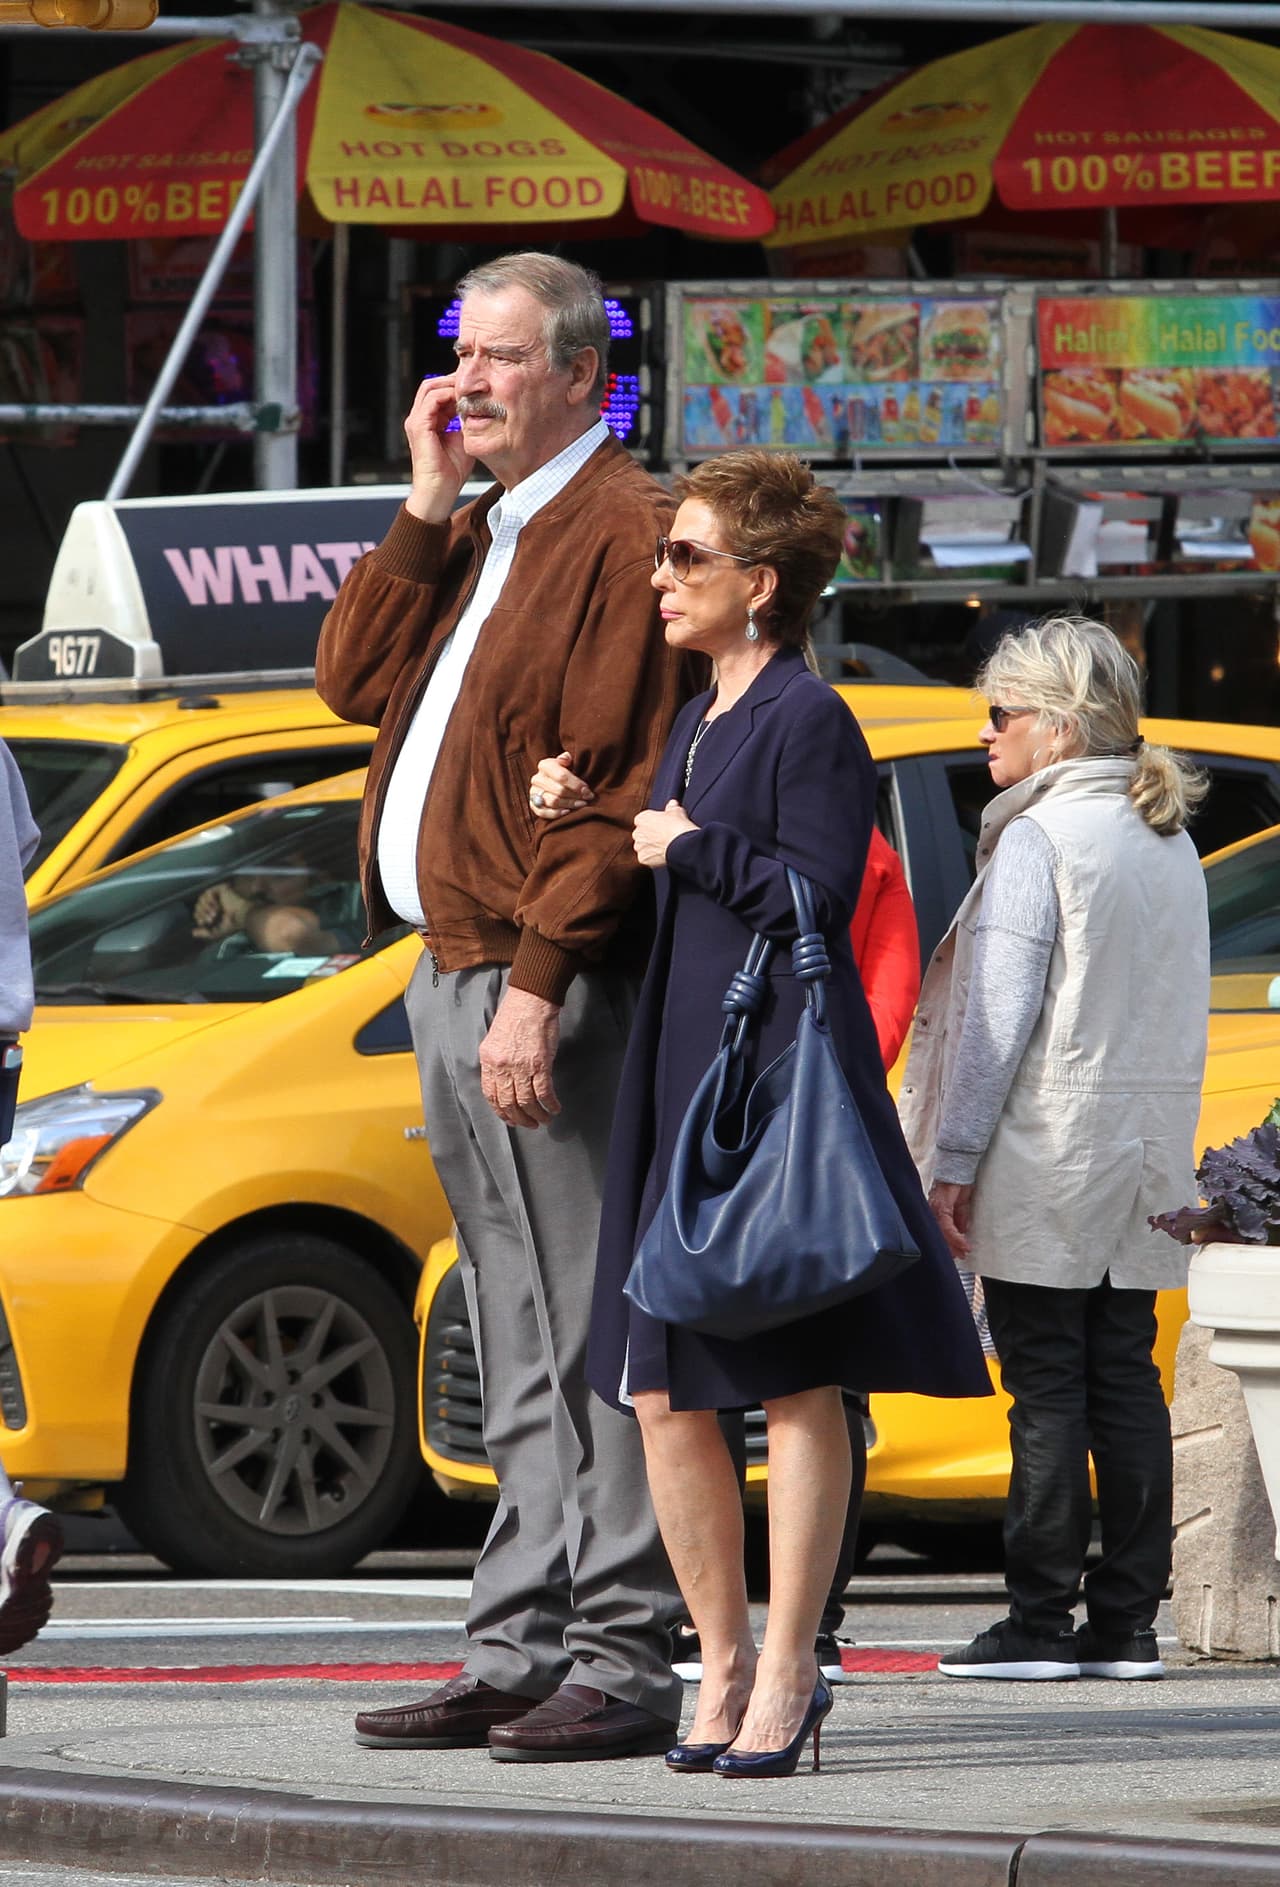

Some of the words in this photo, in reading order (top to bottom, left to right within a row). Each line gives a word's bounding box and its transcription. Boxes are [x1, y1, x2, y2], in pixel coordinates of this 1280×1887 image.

[340, 140, 425, 158] HOT
[440, 138, 567, 158] DOGS
[1034, 131, 1095, 145] HOT
[1102, 126, 1267, 143] SAUSAGES
[73, 153, 136, 171] HOT
[333, 176, 473, 208] HALAL
[484, 175, 605, 208] FOOD
[774, 190, 876, 234] HALAL
[885, 172, 978, 214] FOOD
[1159, 320, 1227, 353] Halal
[48, 635, 101, 676] 9G77
